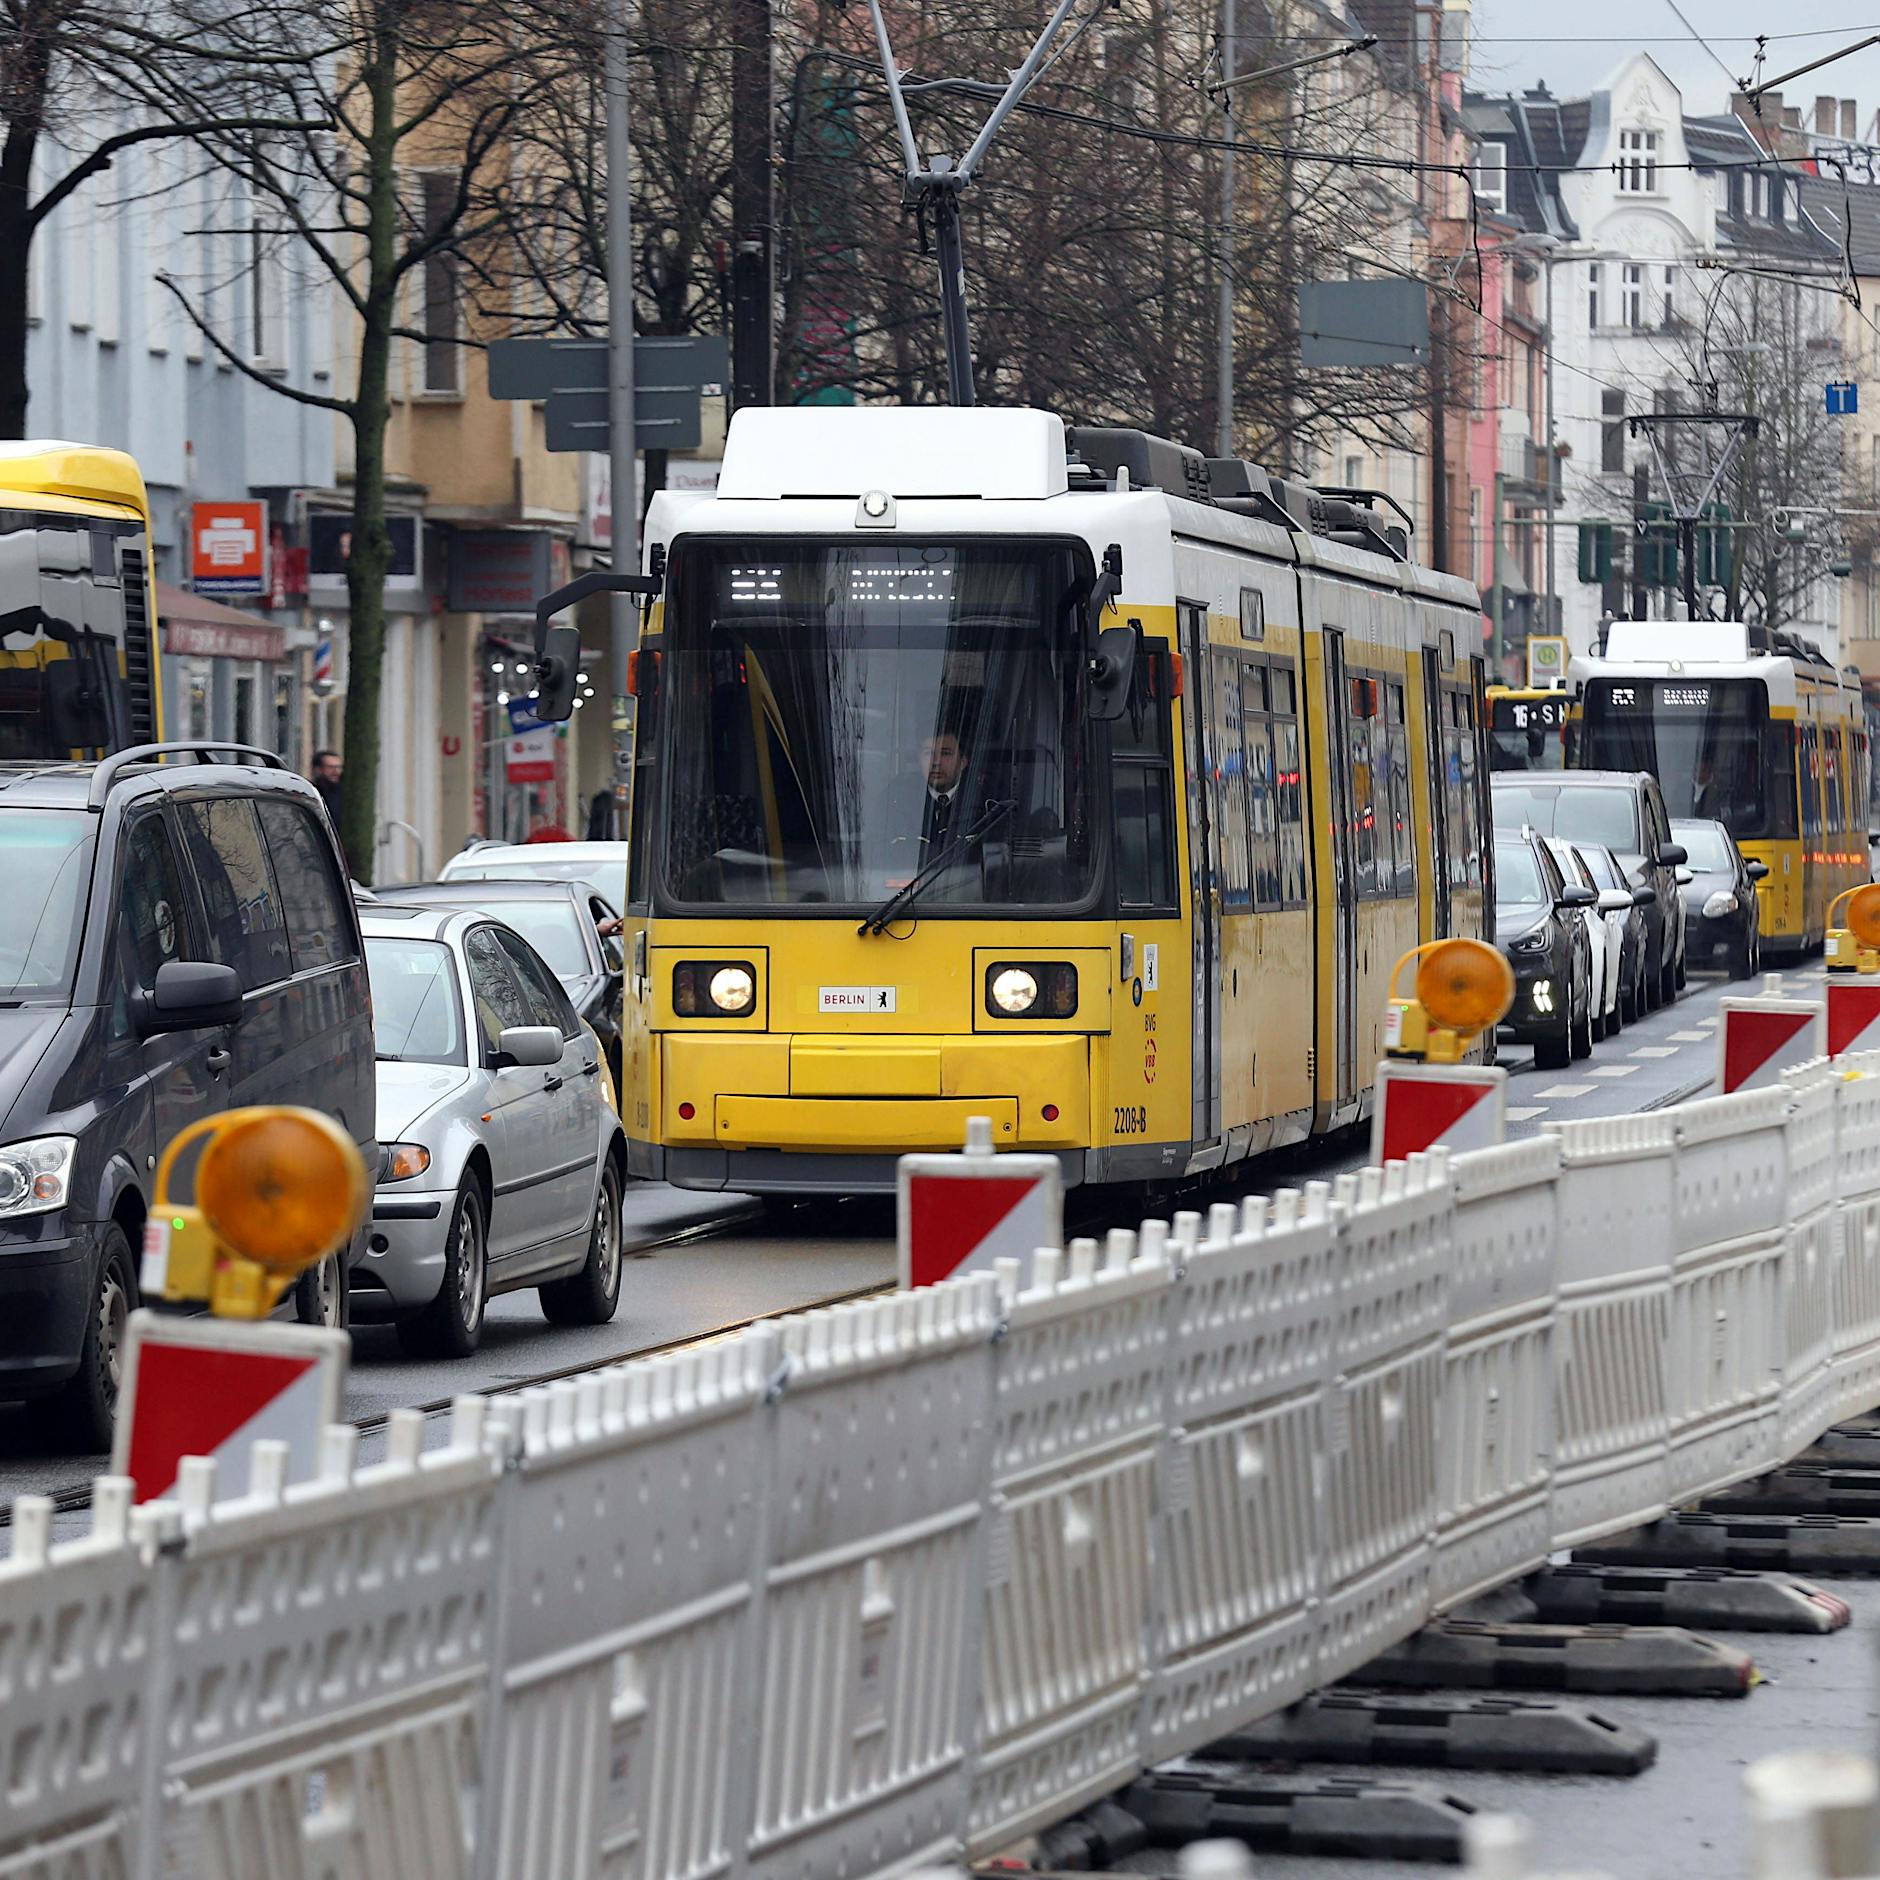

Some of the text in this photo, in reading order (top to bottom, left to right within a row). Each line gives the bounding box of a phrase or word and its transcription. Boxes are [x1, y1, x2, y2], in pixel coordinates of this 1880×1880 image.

[1832, 386, 1851, 411] T
[824, 994, 865, 1005] BERLIN
[1145, 1014, 1156, 1032] BVG
[1145, 1054, 1156, 1068] VBB
[1114, 1106, 1147, 1134] 2208-B
